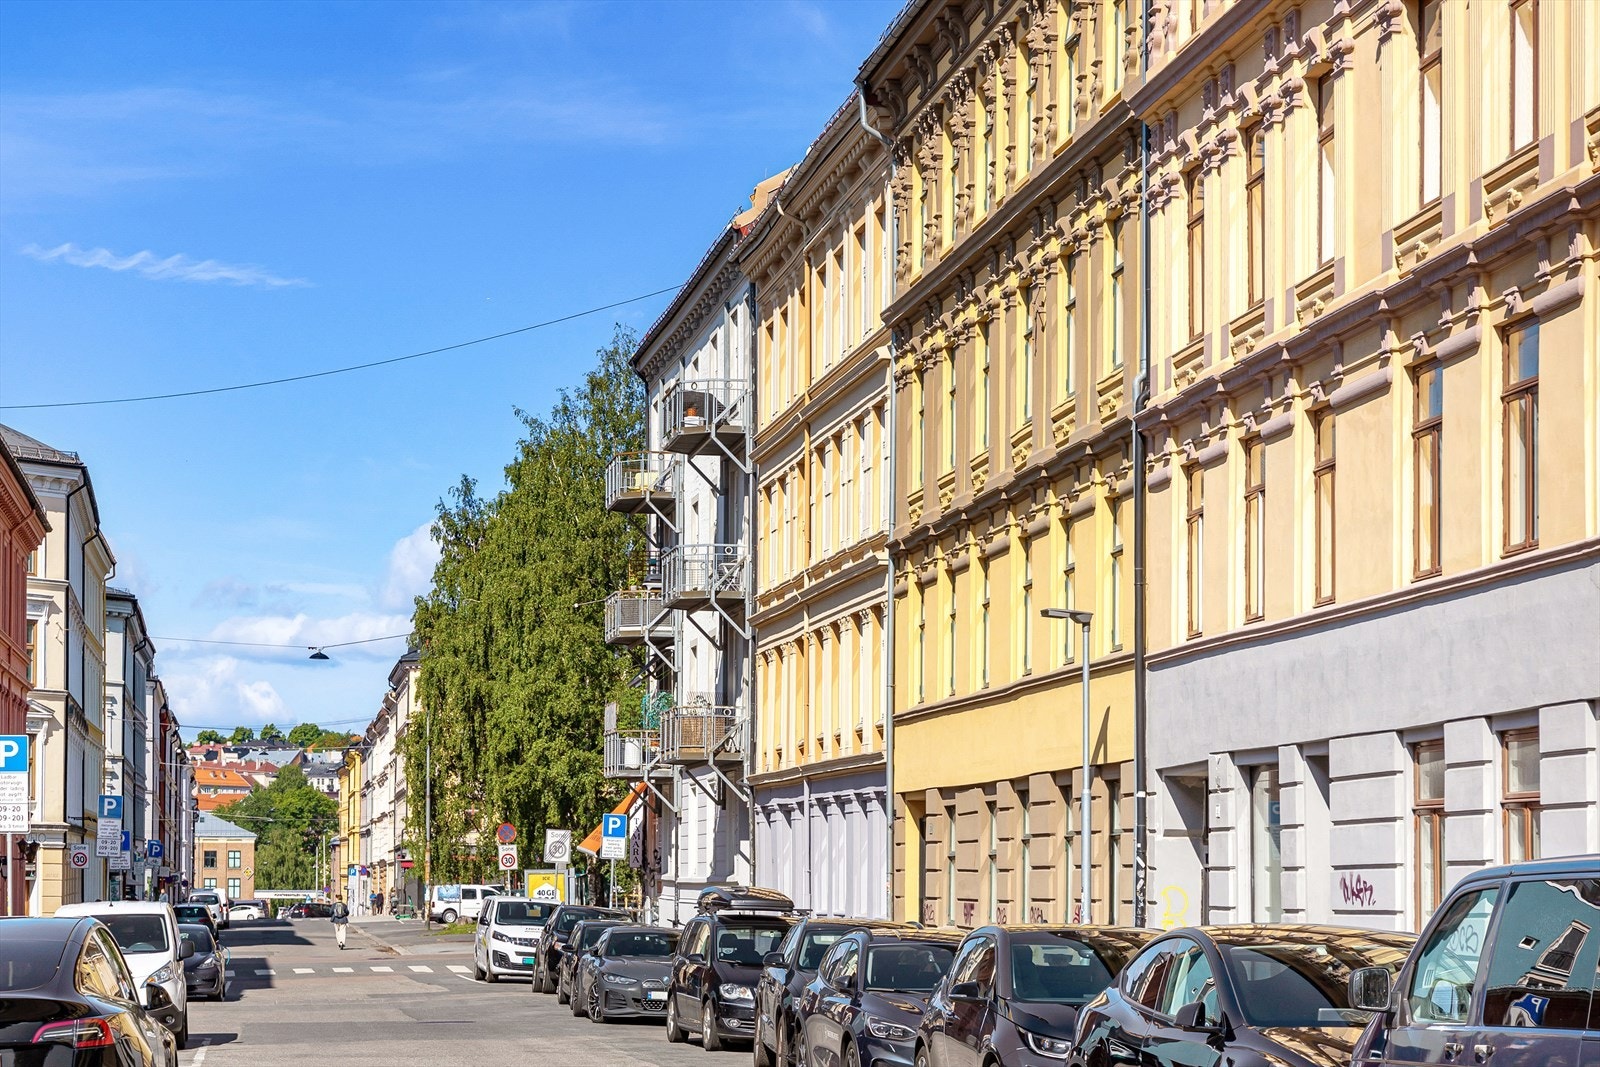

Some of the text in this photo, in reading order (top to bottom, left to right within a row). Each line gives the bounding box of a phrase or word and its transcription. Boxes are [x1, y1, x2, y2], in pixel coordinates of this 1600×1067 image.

[0, 740, 19, 768] P
[103, 798, 117, 816] P
[608, 817, 621, 835] P
[152, 845, 160, 856] P
[504, 857, 513, 865] 30
